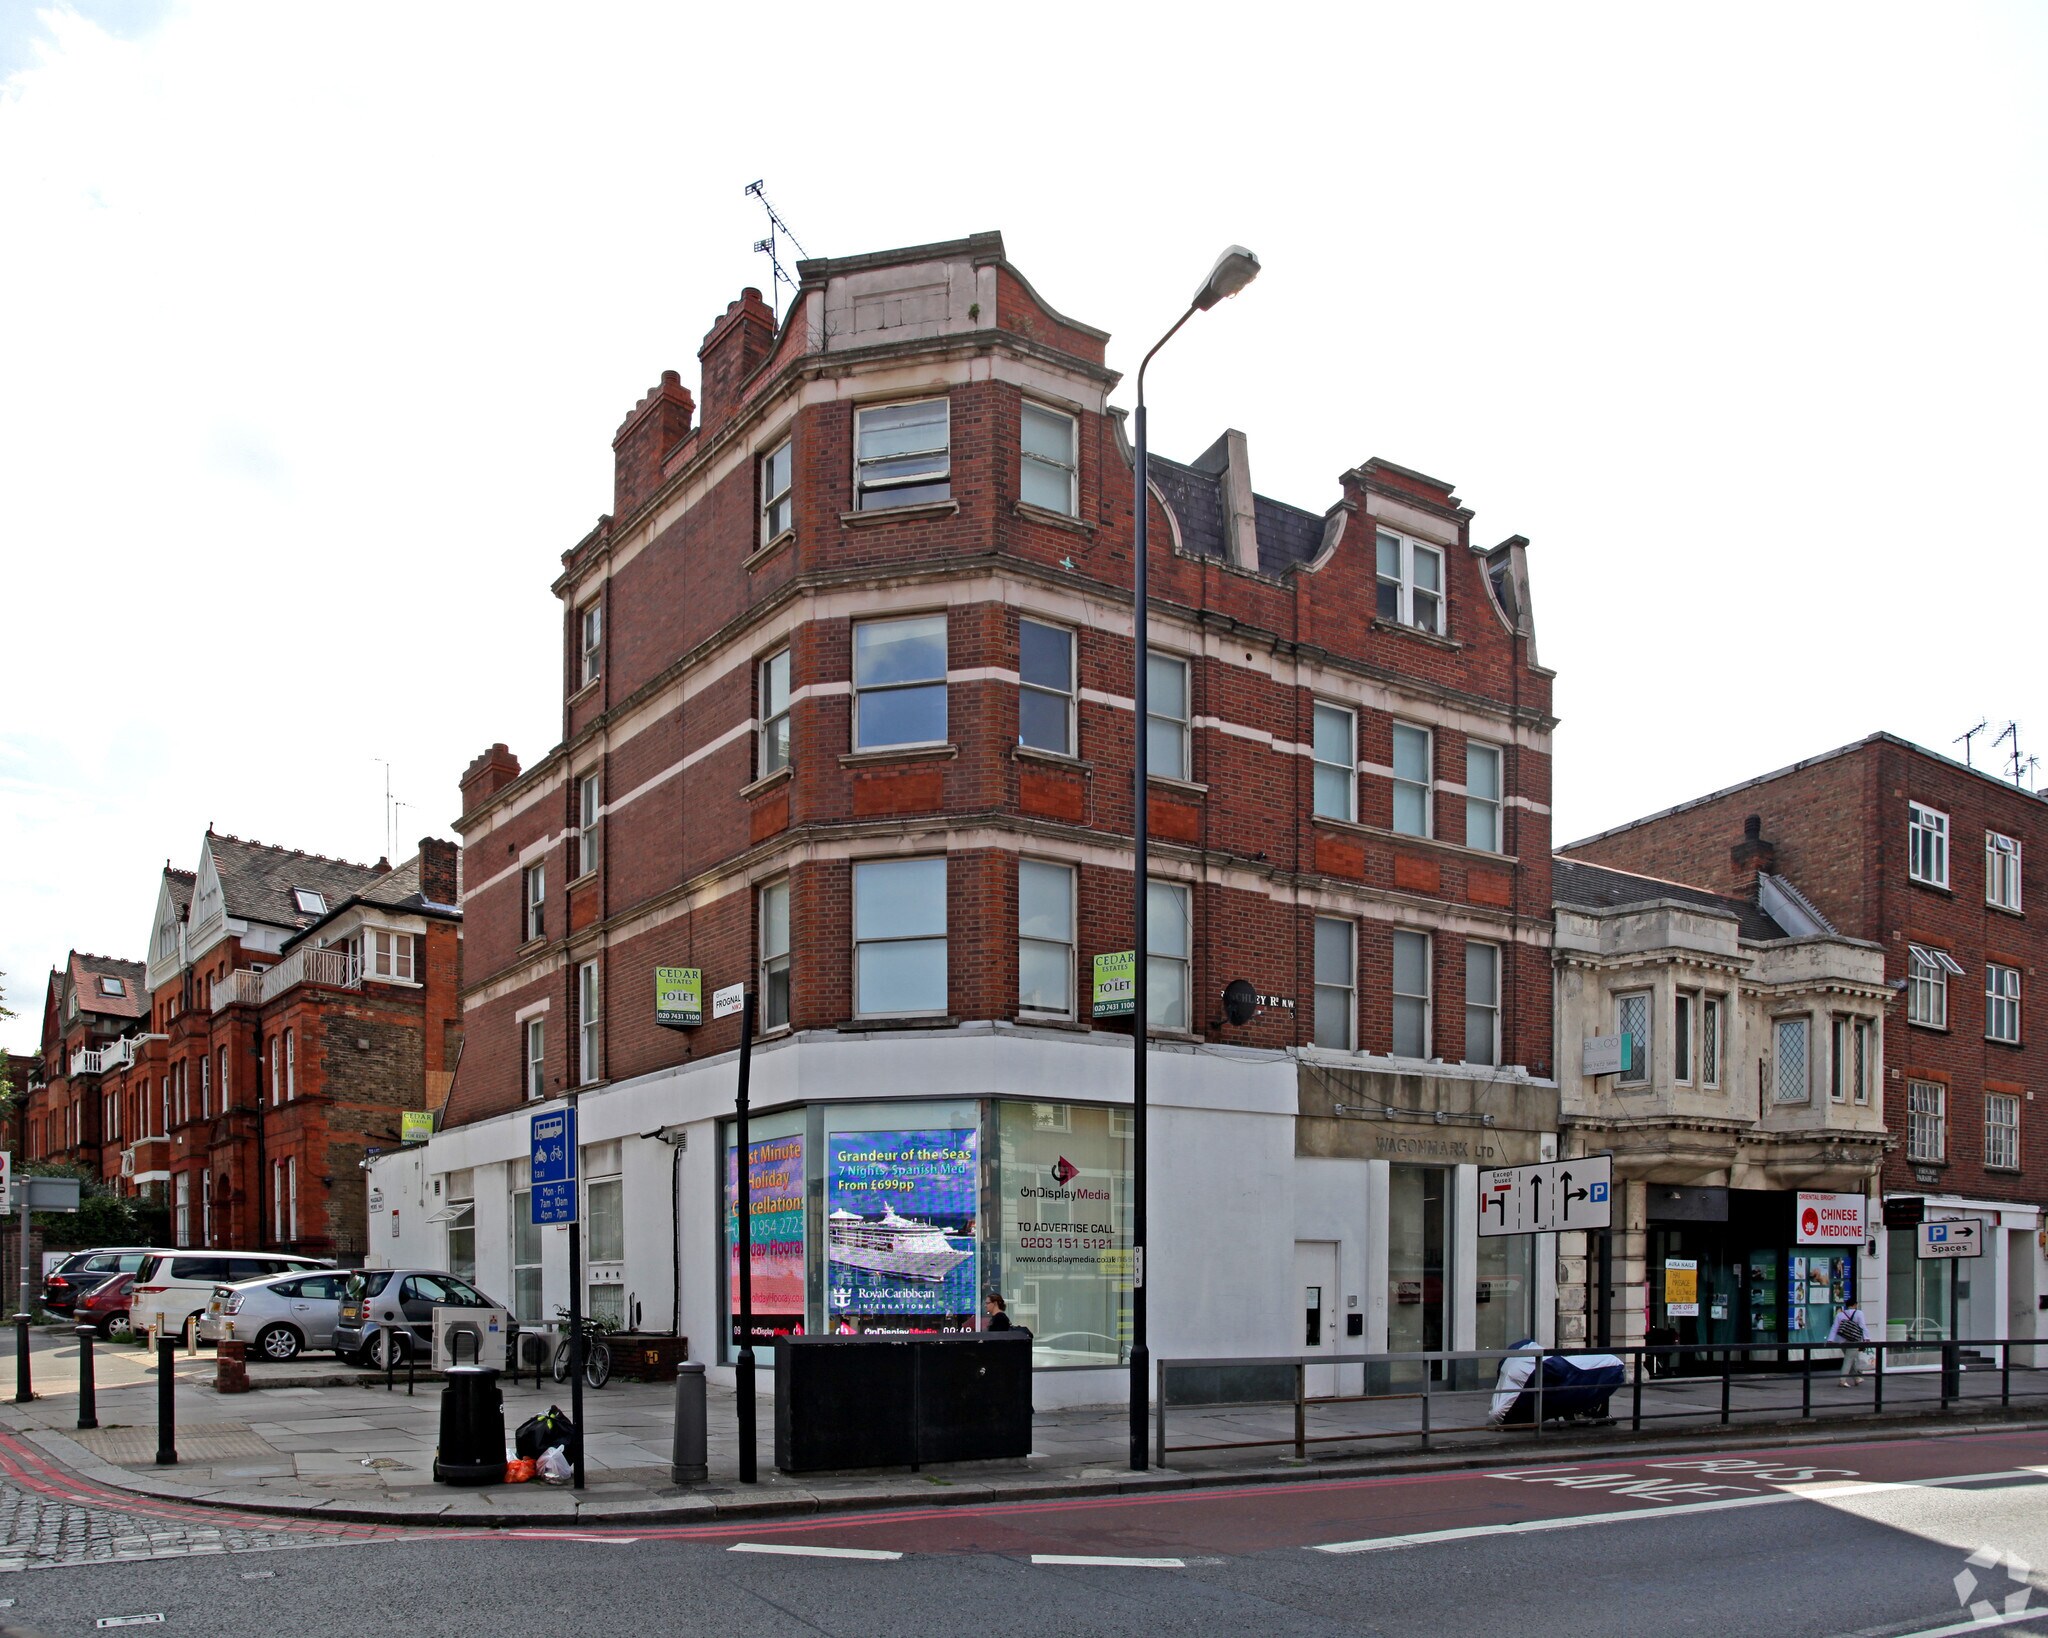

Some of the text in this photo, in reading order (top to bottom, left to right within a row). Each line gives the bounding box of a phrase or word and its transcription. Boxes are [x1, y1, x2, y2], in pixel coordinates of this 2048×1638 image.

[1096, 953, 1135, 966] CEDAR
[658, 969, 699, 979] CEDAR
[1102, 964, 1128, 972] ESTATES
[1098, 980, 1132, 993] TO LET
[662, 992, 694, 1002] TO LET
[716, 994, 741, 1009] FROGNAL
[671, 1012, 684, 1020] 7431
[404, 1112, 432, 1120] CEDAR
[1375, 1136, 1494, 1158] WAGONMARK LTD
[748, 1143, 801, 1165] st Minute
[838, 1148, 972, 1162] Grandeur of the Seas
[534, 1168, 545, 1178] taxi
[839, 1166, 845, 1176] 7
[891, 1164, 938, 1176] Spanish
[940, 1163, 966, 1174] Med
[838, 1179, 915, 1192] From £699pp
[542, 1187, 554, 1197] Mon
[1594, 1185, 1605, 1200] P
[540, 1198, 550, 1208] 7am
[554, 1196, 568, 1207] 10am
[732, 1194, 804, 1217] Ccellations
[540, 1210, 552, 1220] 4pm
[556, 1208, 568, 1218] 7pm
[1821, 1208, 1858, 1220] CHINESE
[759, 1219, 776, 1236] 954
[780, 1216, 804, 1234] 2723
[1018, 1222, 1114, 1234] TO ADVERTISE CALL
[1820, 1225, 1862, 1236] MEDICINE
[1932, 1227, 1944, 1240] P
[1020, 1238, 1112, 1249] 0203 151 5121
[1931, 1244, 1968, 1254] Spaces
[1016, 1256, 1116, 1265] www.ondisplaymedia.co.uk
[1645, 1459, 1861, 1482] BUS
[1482, 1468, 1762, 1502] LANE
